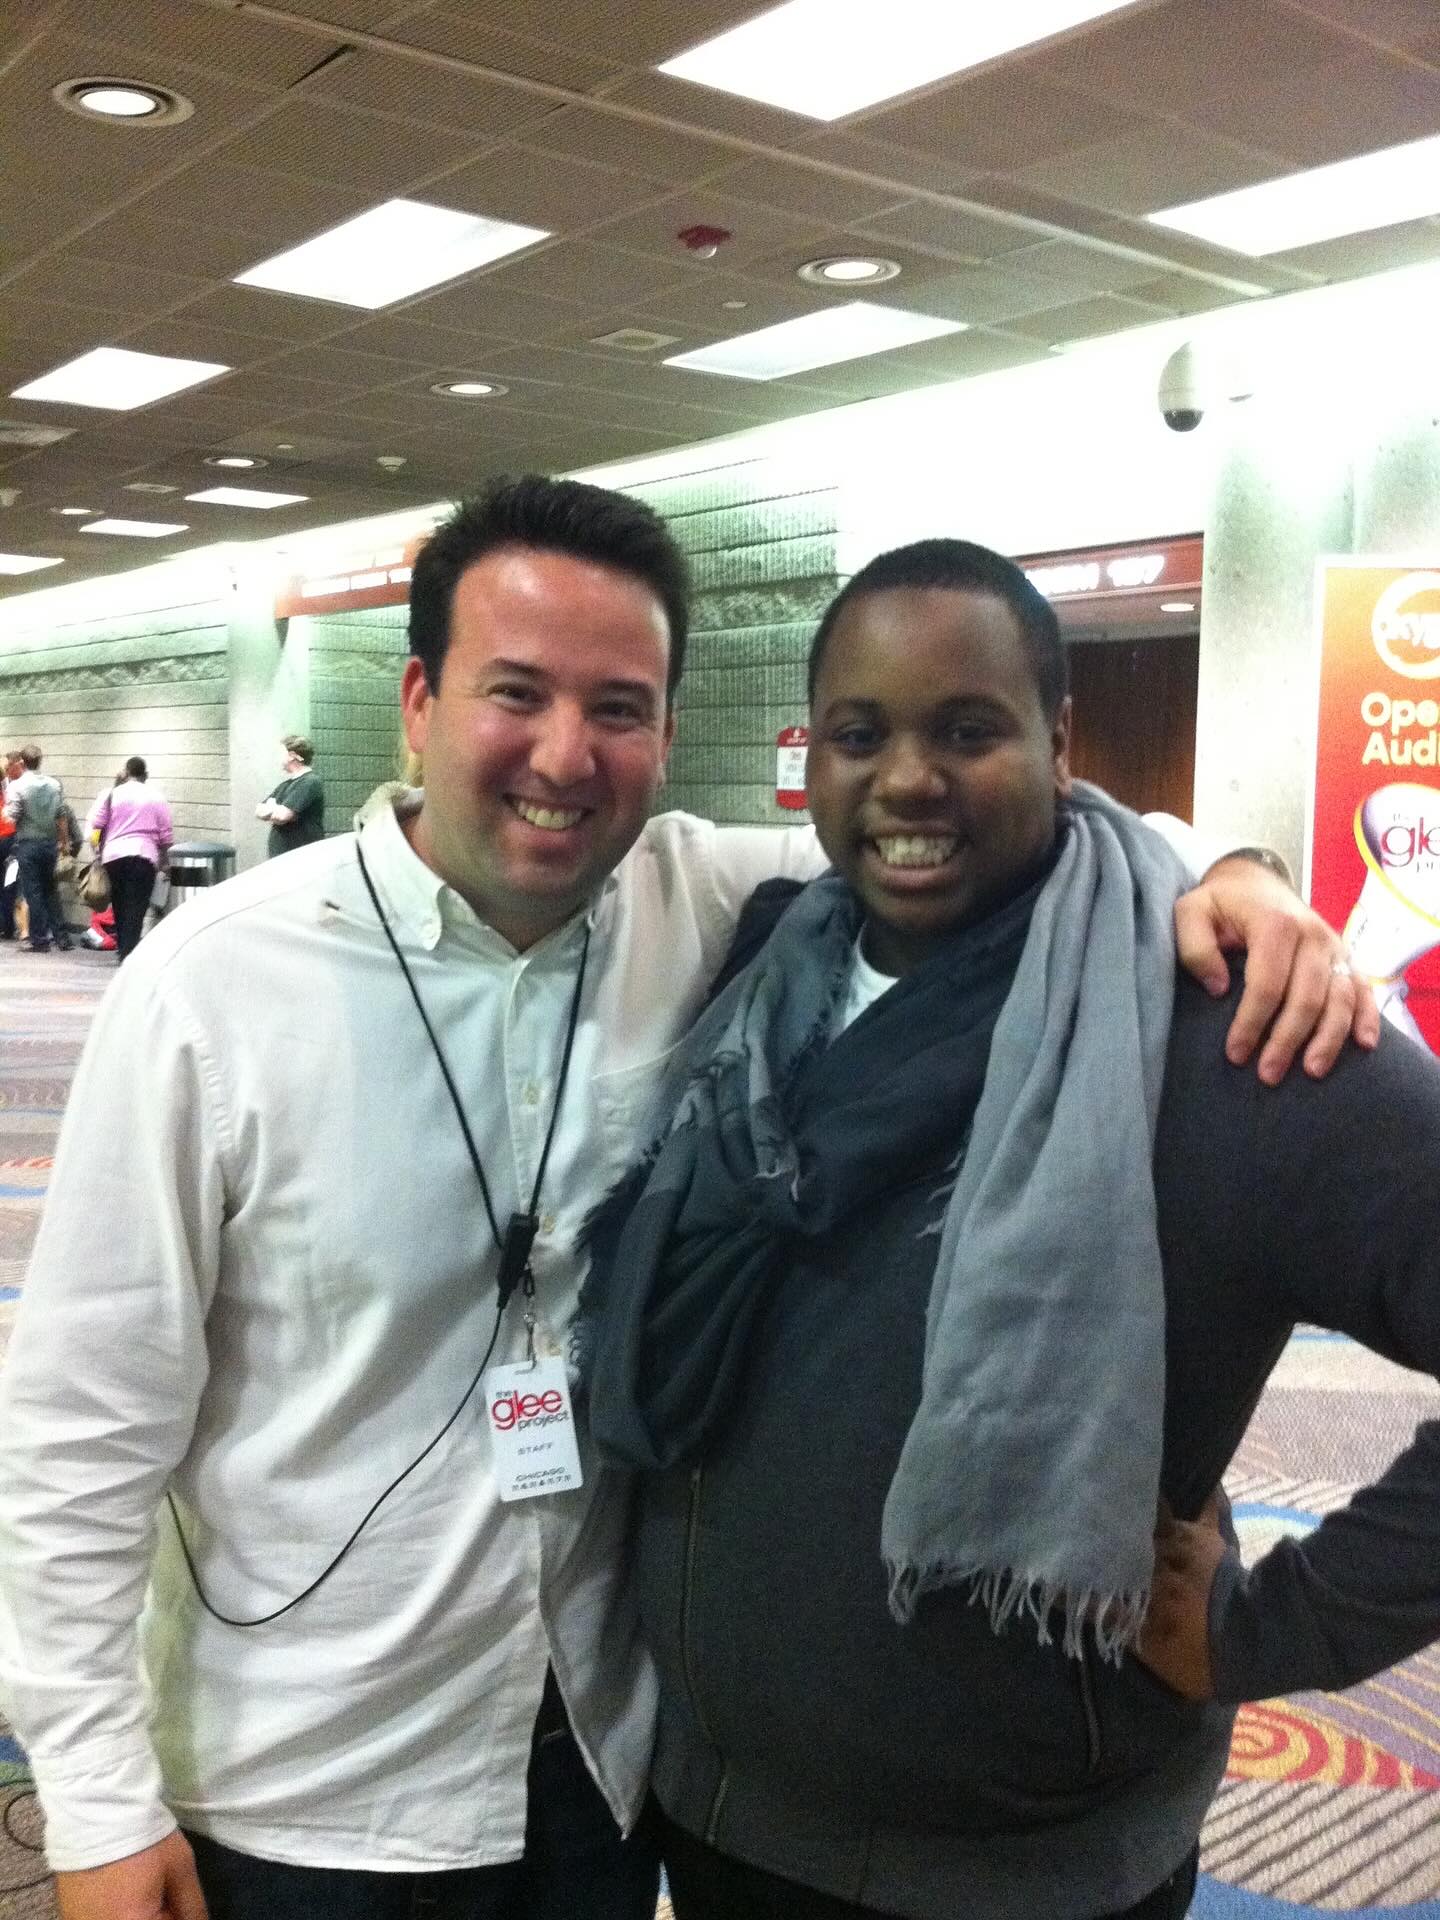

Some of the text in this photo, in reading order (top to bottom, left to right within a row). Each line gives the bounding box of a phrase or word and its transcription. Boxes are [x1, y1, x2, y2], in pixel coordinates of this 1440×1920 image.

[1361, 692, 1440, 736] Ope
[492, 1390, 562, 1430] glee
[518, 1411, 569, 1431] project
[517, 1441, 553, 1455] STAFF
[515, 1467, 566, 1482] CHICAGO
